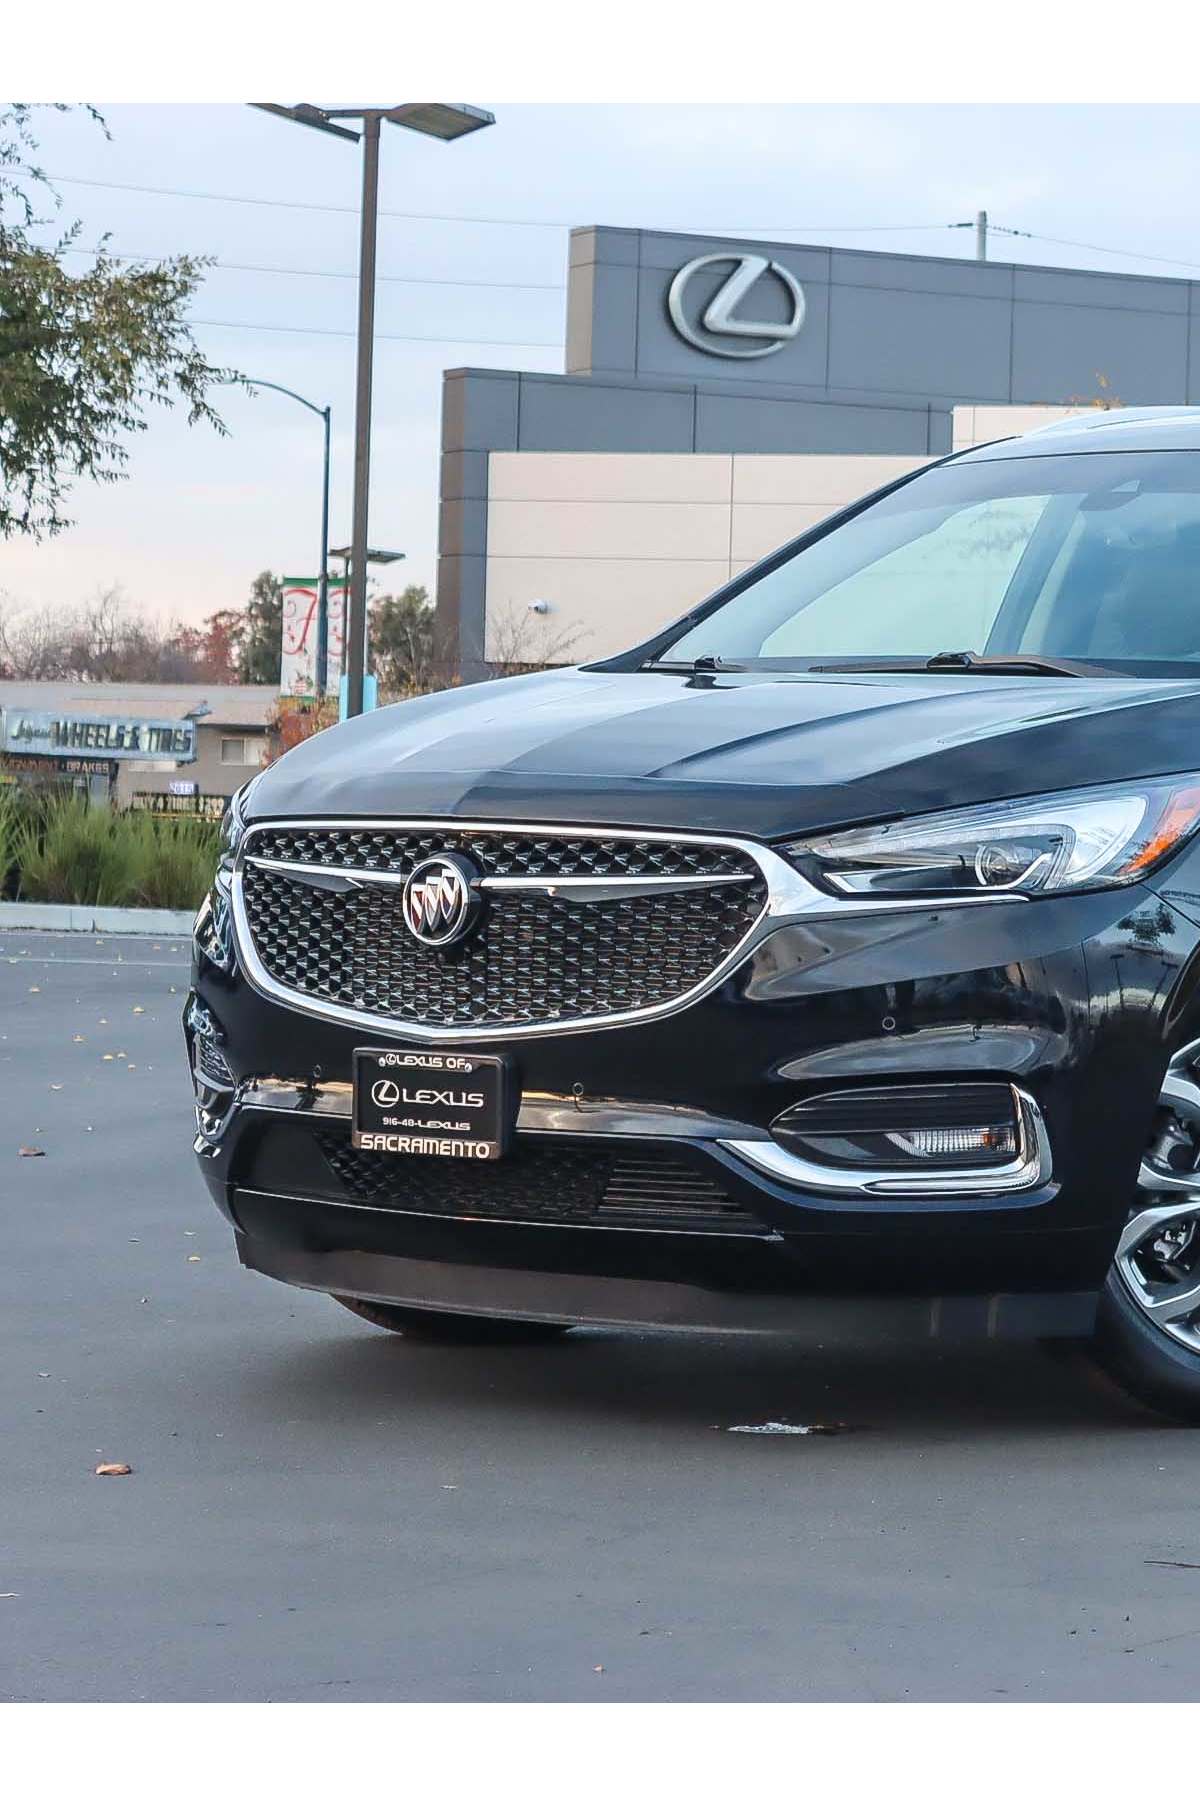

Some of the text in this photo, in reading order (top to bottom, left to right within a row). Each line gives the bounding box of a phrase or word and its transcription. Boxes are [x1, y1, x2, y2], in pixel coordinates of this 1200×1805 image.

[54, 720, 123, 749] WHEELS
[148, 727, 193, 752] TIRES
[66, 761, 110, 776] BRAKES
[397, 1054, 466, 1070] LEXUS OF
[402, 1088, 484, 1108] LEXUS
[382, 1117, 471, 1131] 916-48-LEXUS
[360, 1134, 490, 1159] SACRAMENTO
